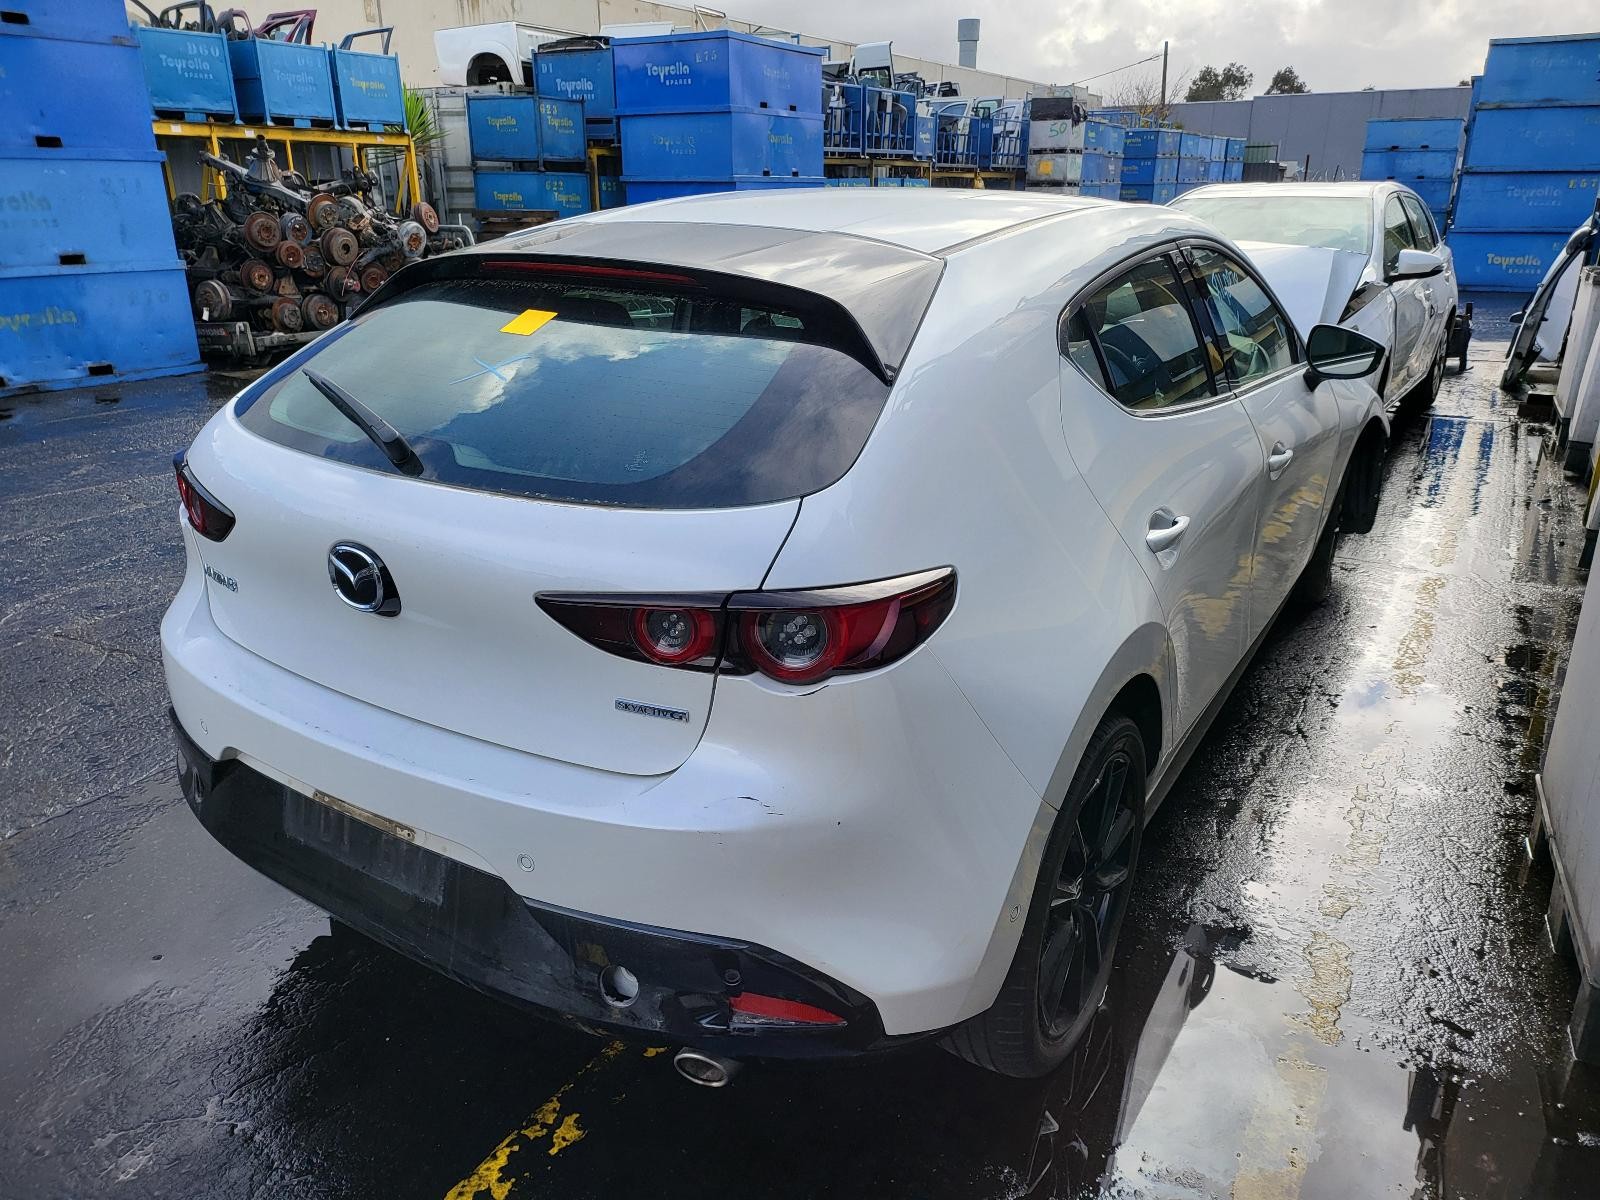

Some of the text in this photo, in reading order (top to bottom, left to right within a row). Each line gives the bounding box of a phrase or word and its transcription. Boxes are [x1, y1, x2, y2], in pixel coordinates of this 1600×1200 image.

[541, 63, 553, 74] D1
[646, 61, 690, 83] Toyrolla
[556, 77, 594, 98] Toyrolla
[665, 78, 692, 87] SPARES
[1048, 121, 1069, 138] 50
[1486, 253, 1541, 271] Toyrolla
[617, 700, 669, 718] SKYACTIV
